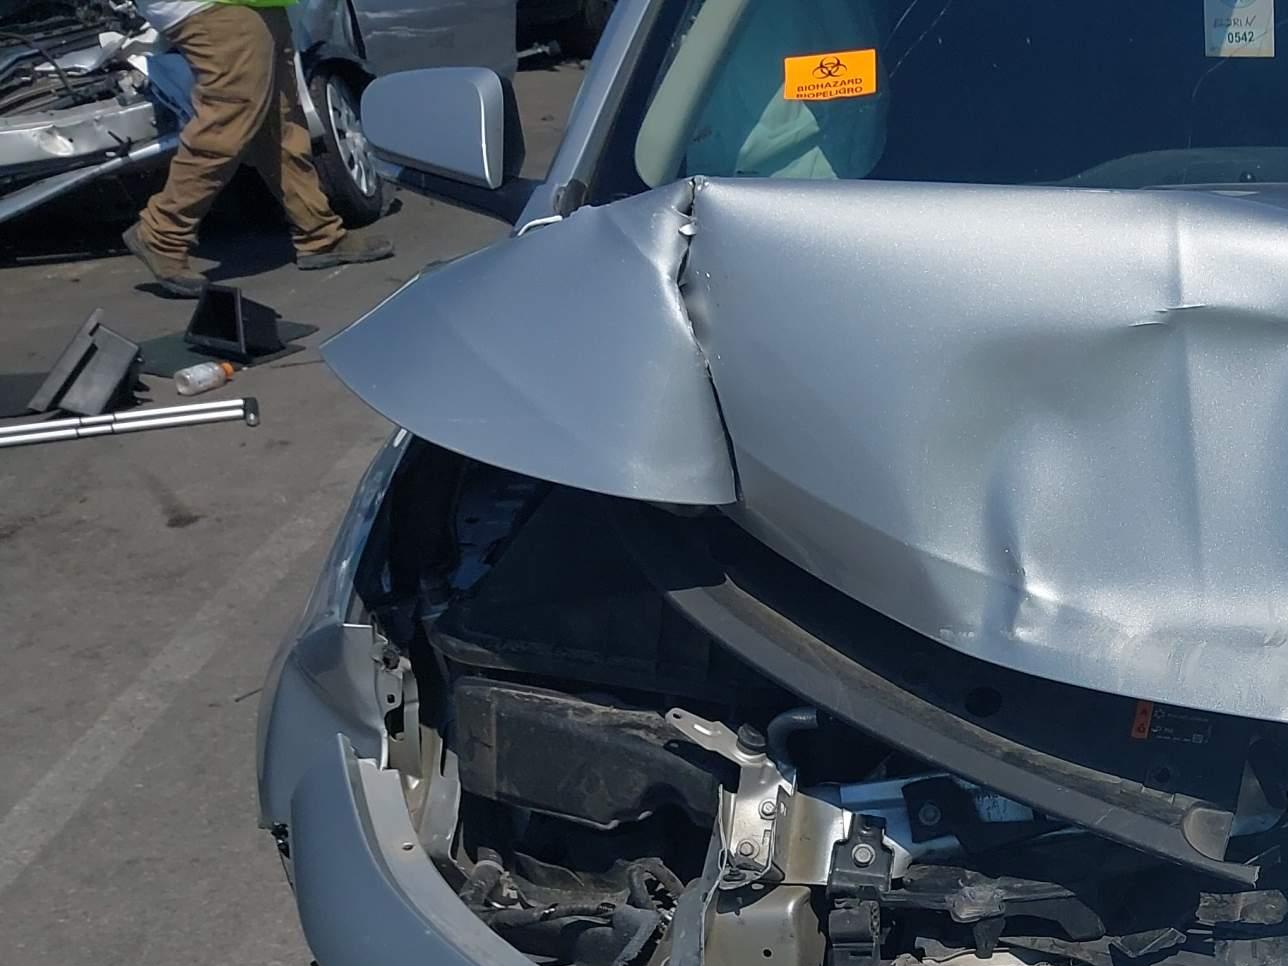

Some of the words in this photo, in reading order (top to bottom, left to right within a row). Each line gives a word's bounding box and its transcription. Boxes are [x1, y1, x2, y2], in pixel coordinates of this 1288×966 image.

[1227, 31, 1255, 44] 0542
[797, 78, 863, 93] BIOHAZARD
[796, 87, 864, 99] BIOPELIGRO
